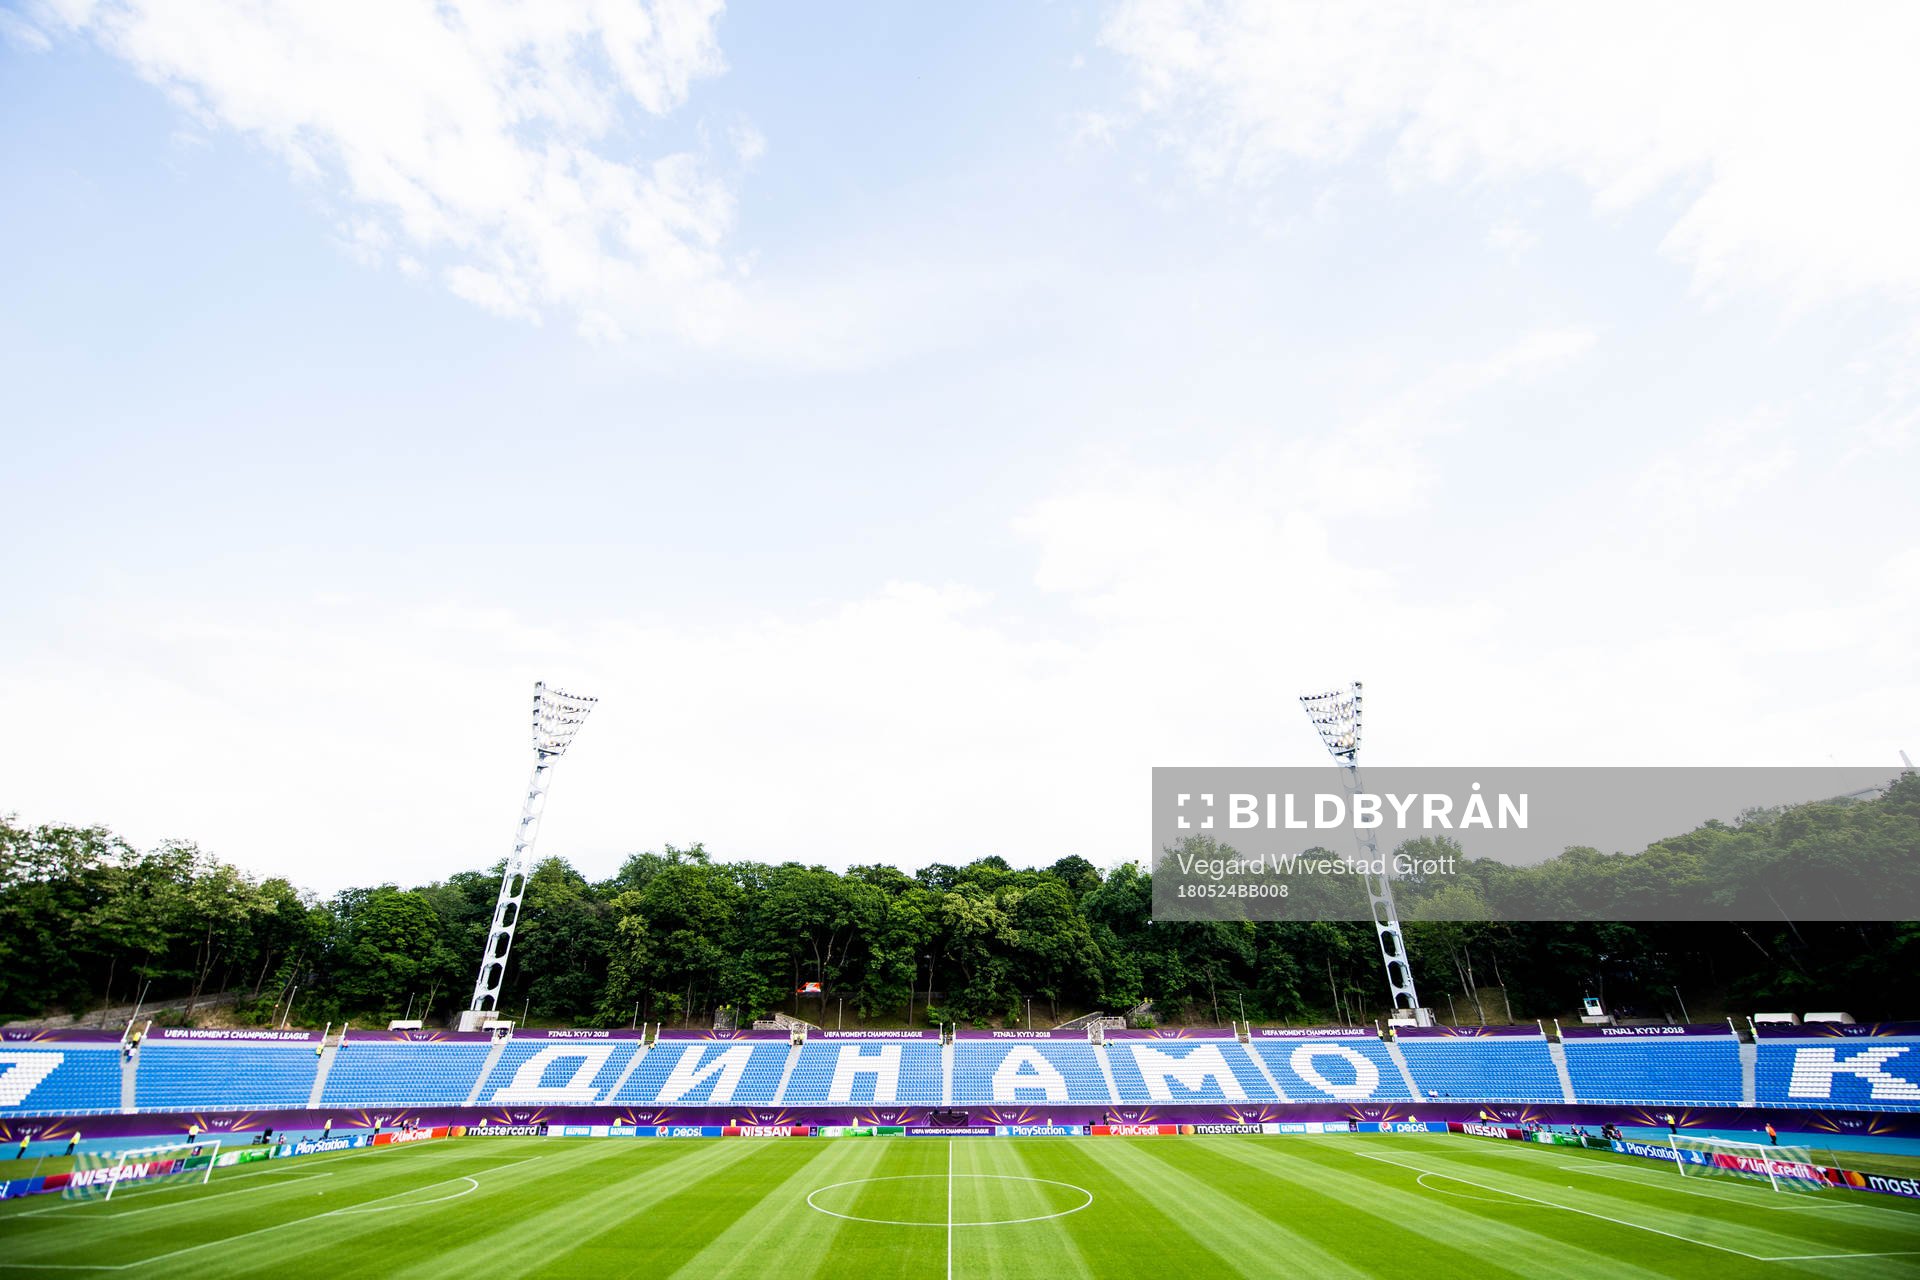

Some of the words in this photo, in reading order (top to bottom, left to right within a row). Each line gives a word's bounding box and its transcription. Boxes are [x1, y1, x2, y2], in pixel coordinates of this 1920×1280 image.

[164, 1030, 189, 1038] UEFA
[190, 1030, 230, 1039] WOMEN'S
[230, 1031, 279, 1039] CHAMPIONS
[279, 1032, 310, 1040] LEAGUE
[1341, 1028, 1365, 1036] LEAGUE
[1601, 1028, 1635, 1036] FINAL
[1635, 1027, 1660, 1035] KYIV
[1661, 1026, 1685, 1034] 2018
[468, 1125, 538, 1136] mastercard
[672, 1126, 702, 1137] pepsi
[740, 1126, 792, 1137] NISSAN
[1012, 1126, 1067, 1138] PlayStation
[1119, 1124, 1159, 1136] UniCredit
[1197, 1124, 1260, 1134] mastercard
[1397, 1122, 1429, 1133] pepsi
[1462, 1123, 1508, 1139] NISSAN
[295, 1138, 349, 1154] PlayStation
[1748, 1158, 1811, 1179] UnCredit
[71, 1162, 151, 1188] NISSAN
